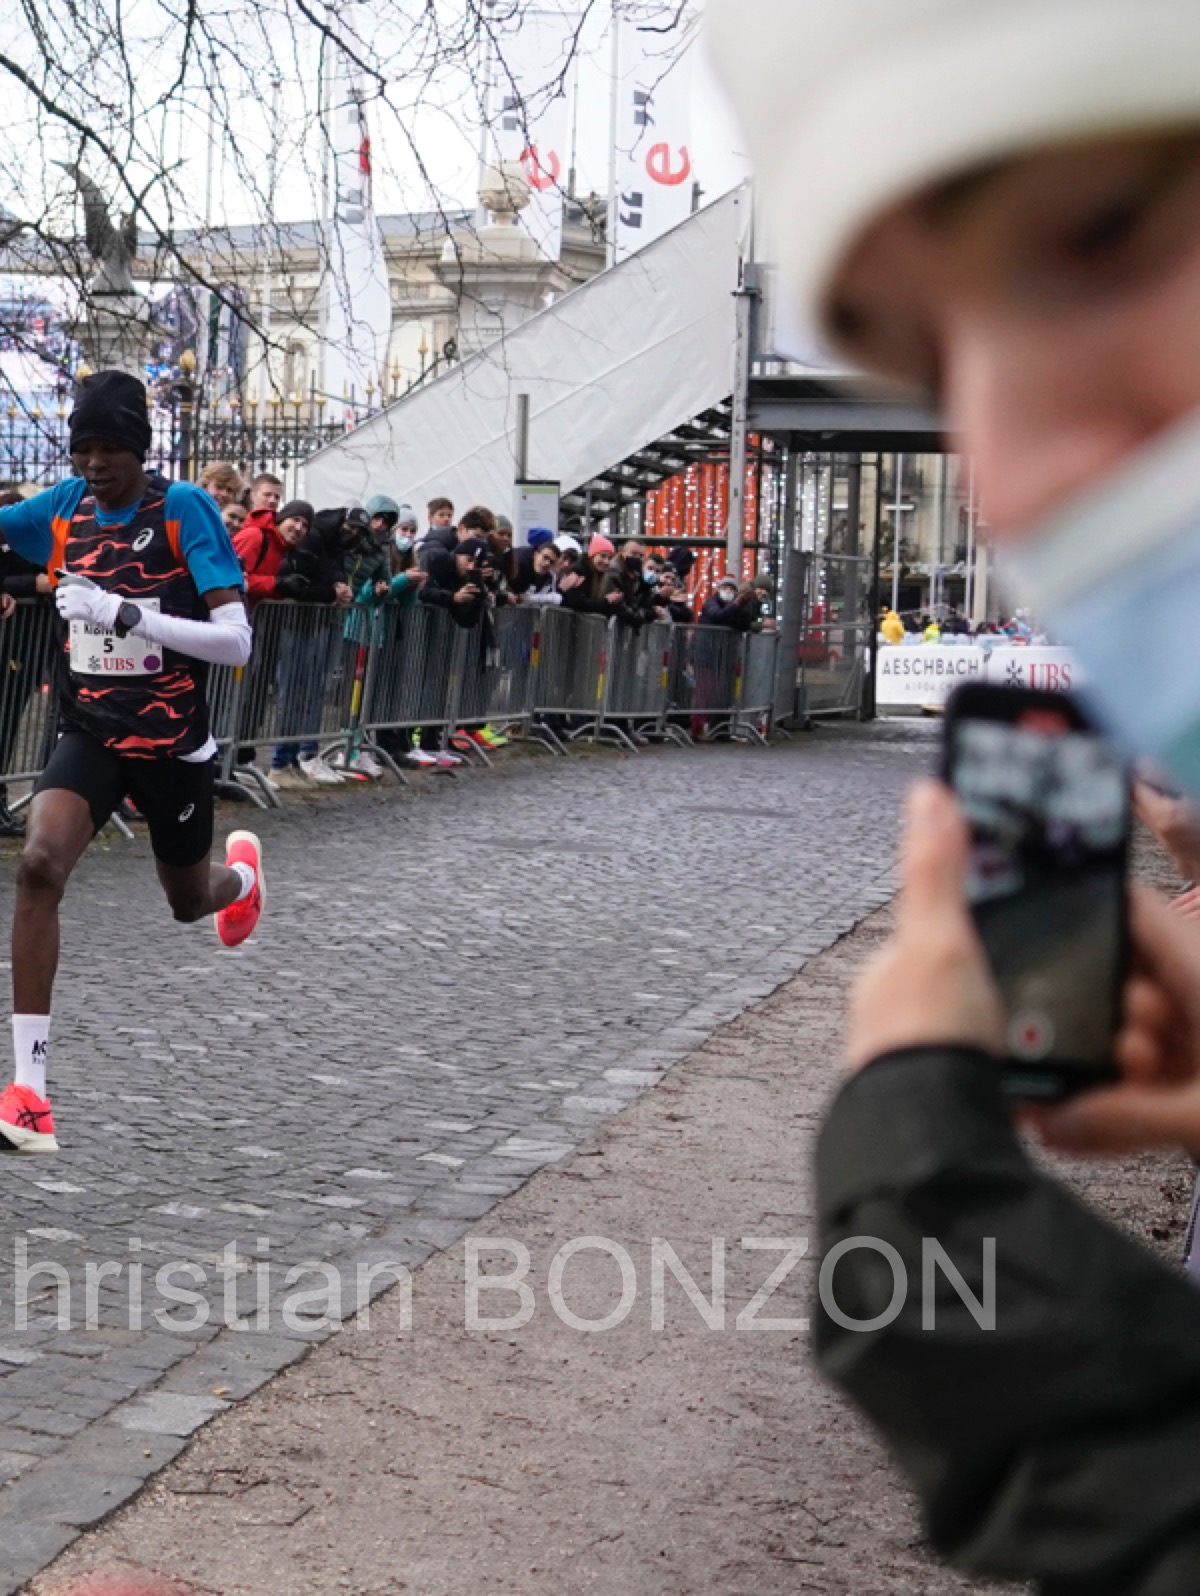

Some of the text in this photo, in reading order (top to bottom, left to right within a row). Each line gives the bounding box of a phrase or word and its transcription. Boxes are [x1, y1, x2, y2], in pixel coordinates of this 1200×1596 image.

[103, 637, 114, 653] 5
[103, 657, 135, 671] UBS
[882, 657, 979, 675] AESCHBACH
[1029, 663, 1072, 692] UBS
